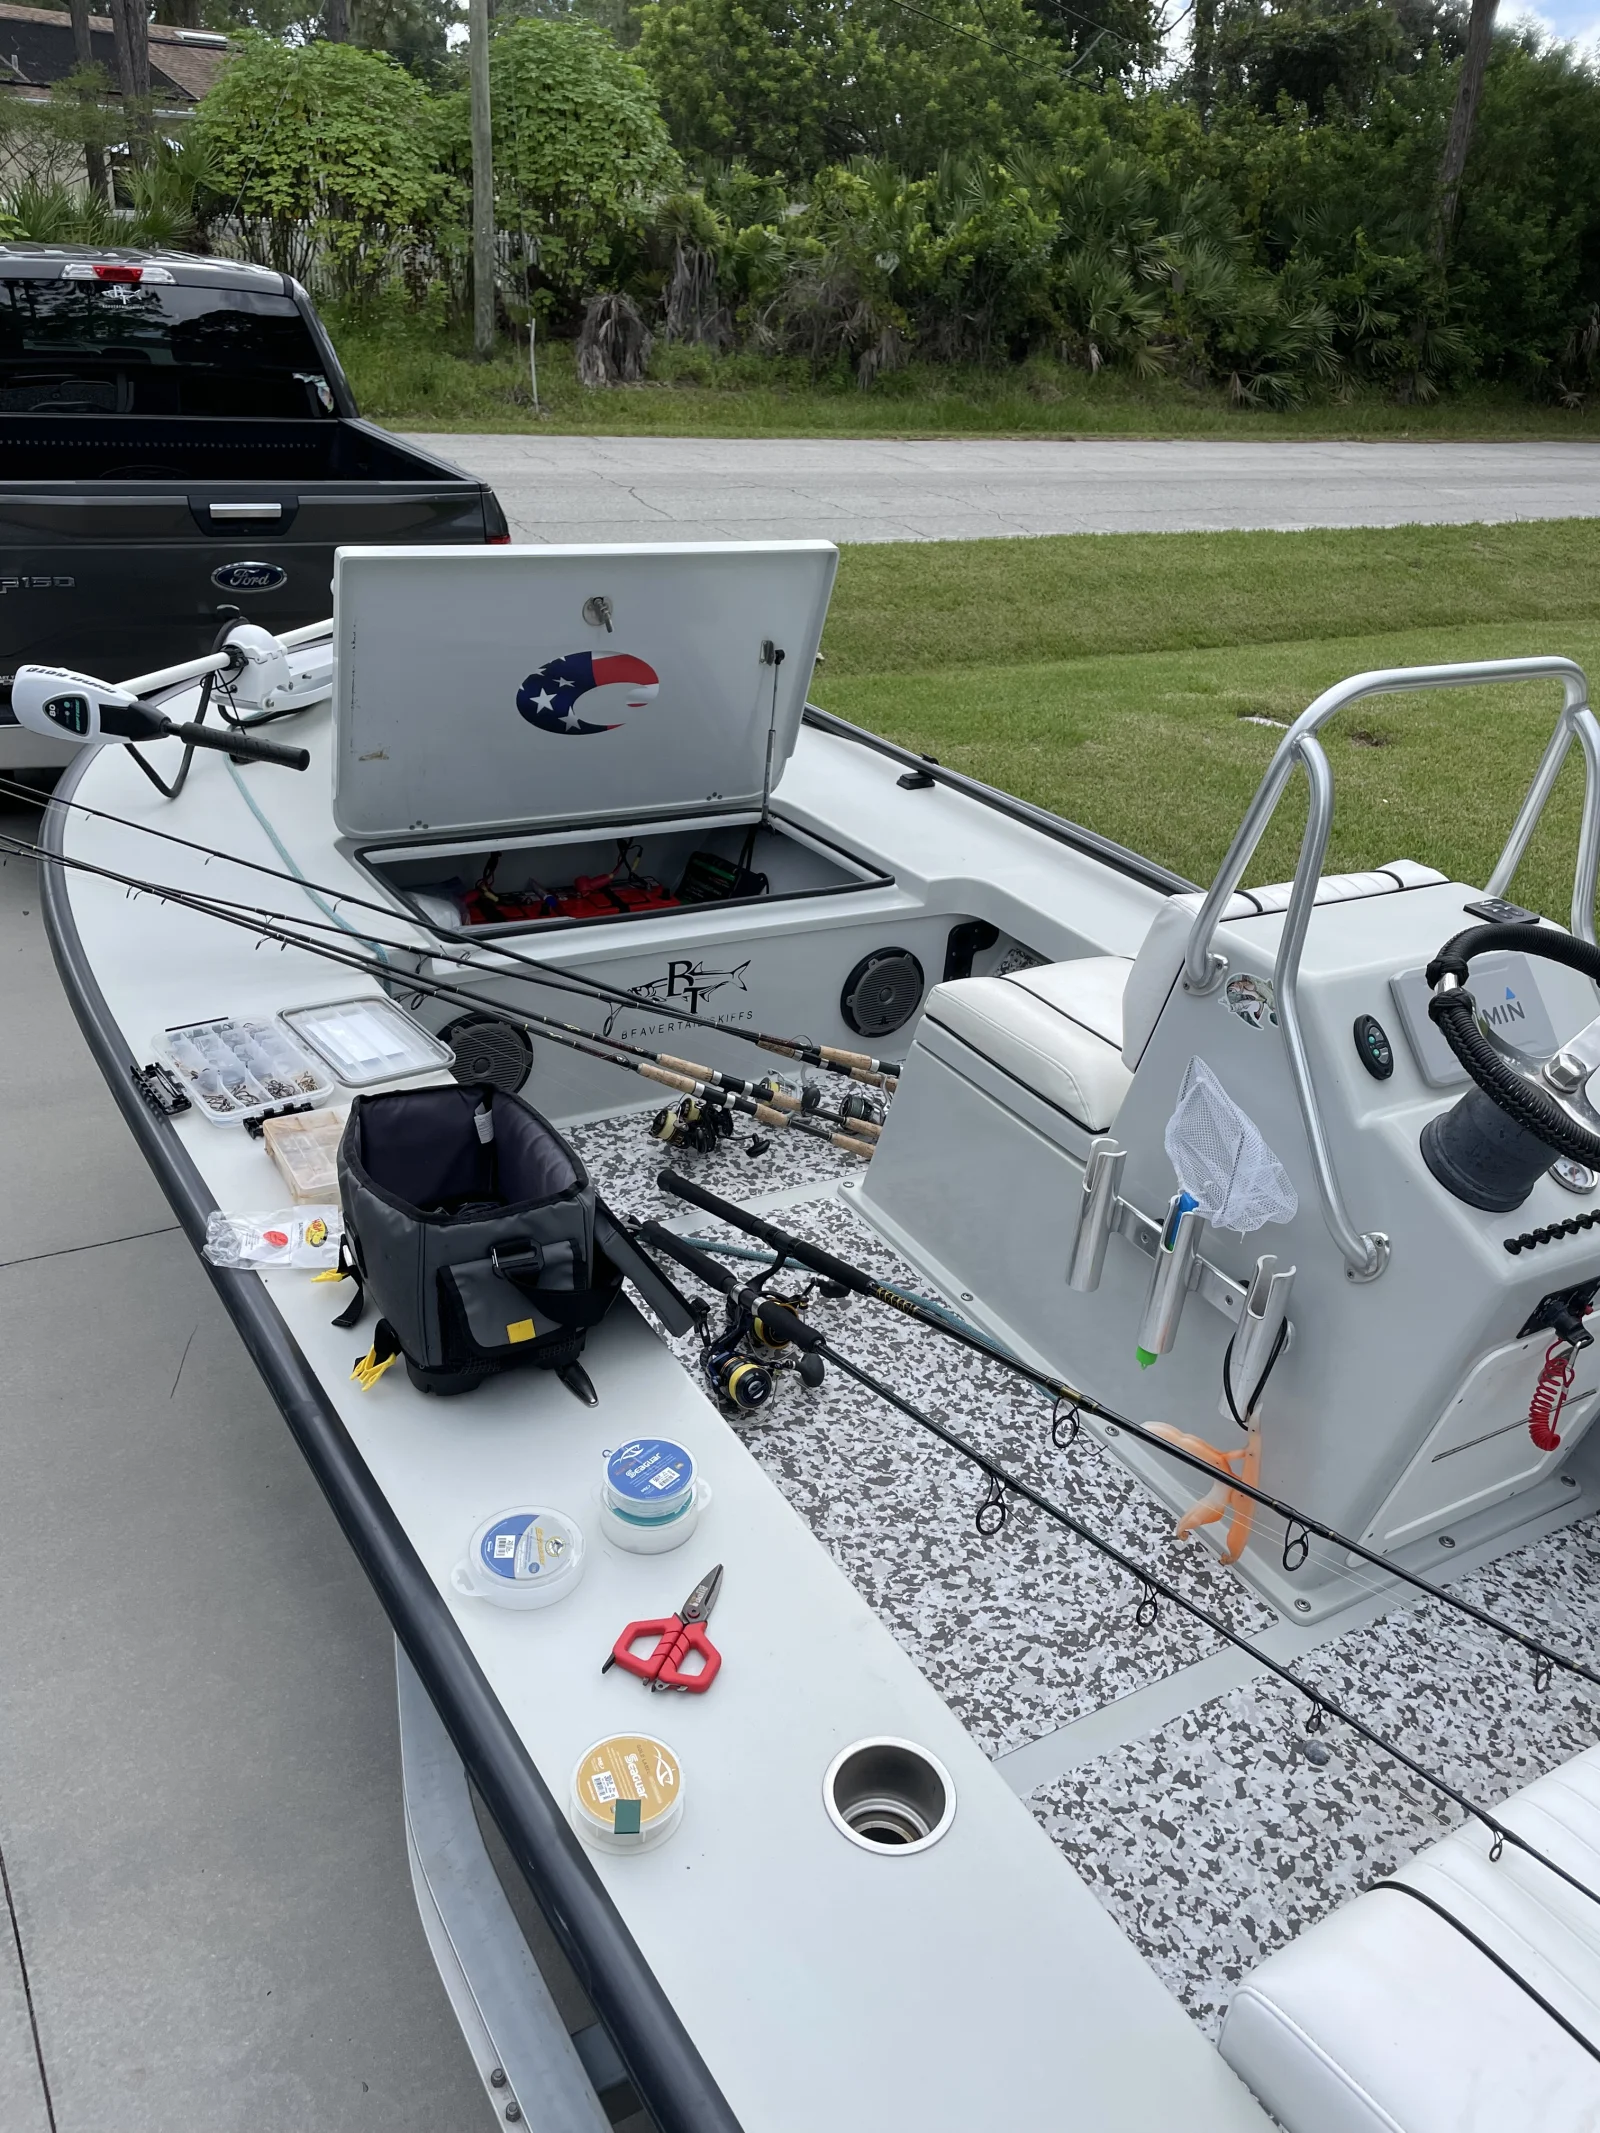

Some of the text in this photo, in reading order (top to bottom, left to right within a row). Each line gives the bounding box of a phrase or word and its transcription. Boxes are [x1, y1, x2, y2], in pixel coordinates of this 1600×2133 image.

[229, 568, 270, 587] Ford
[1482, 1001, 1526, 1026] MIN
[624, 1753, 649, 1799] Seaguar
